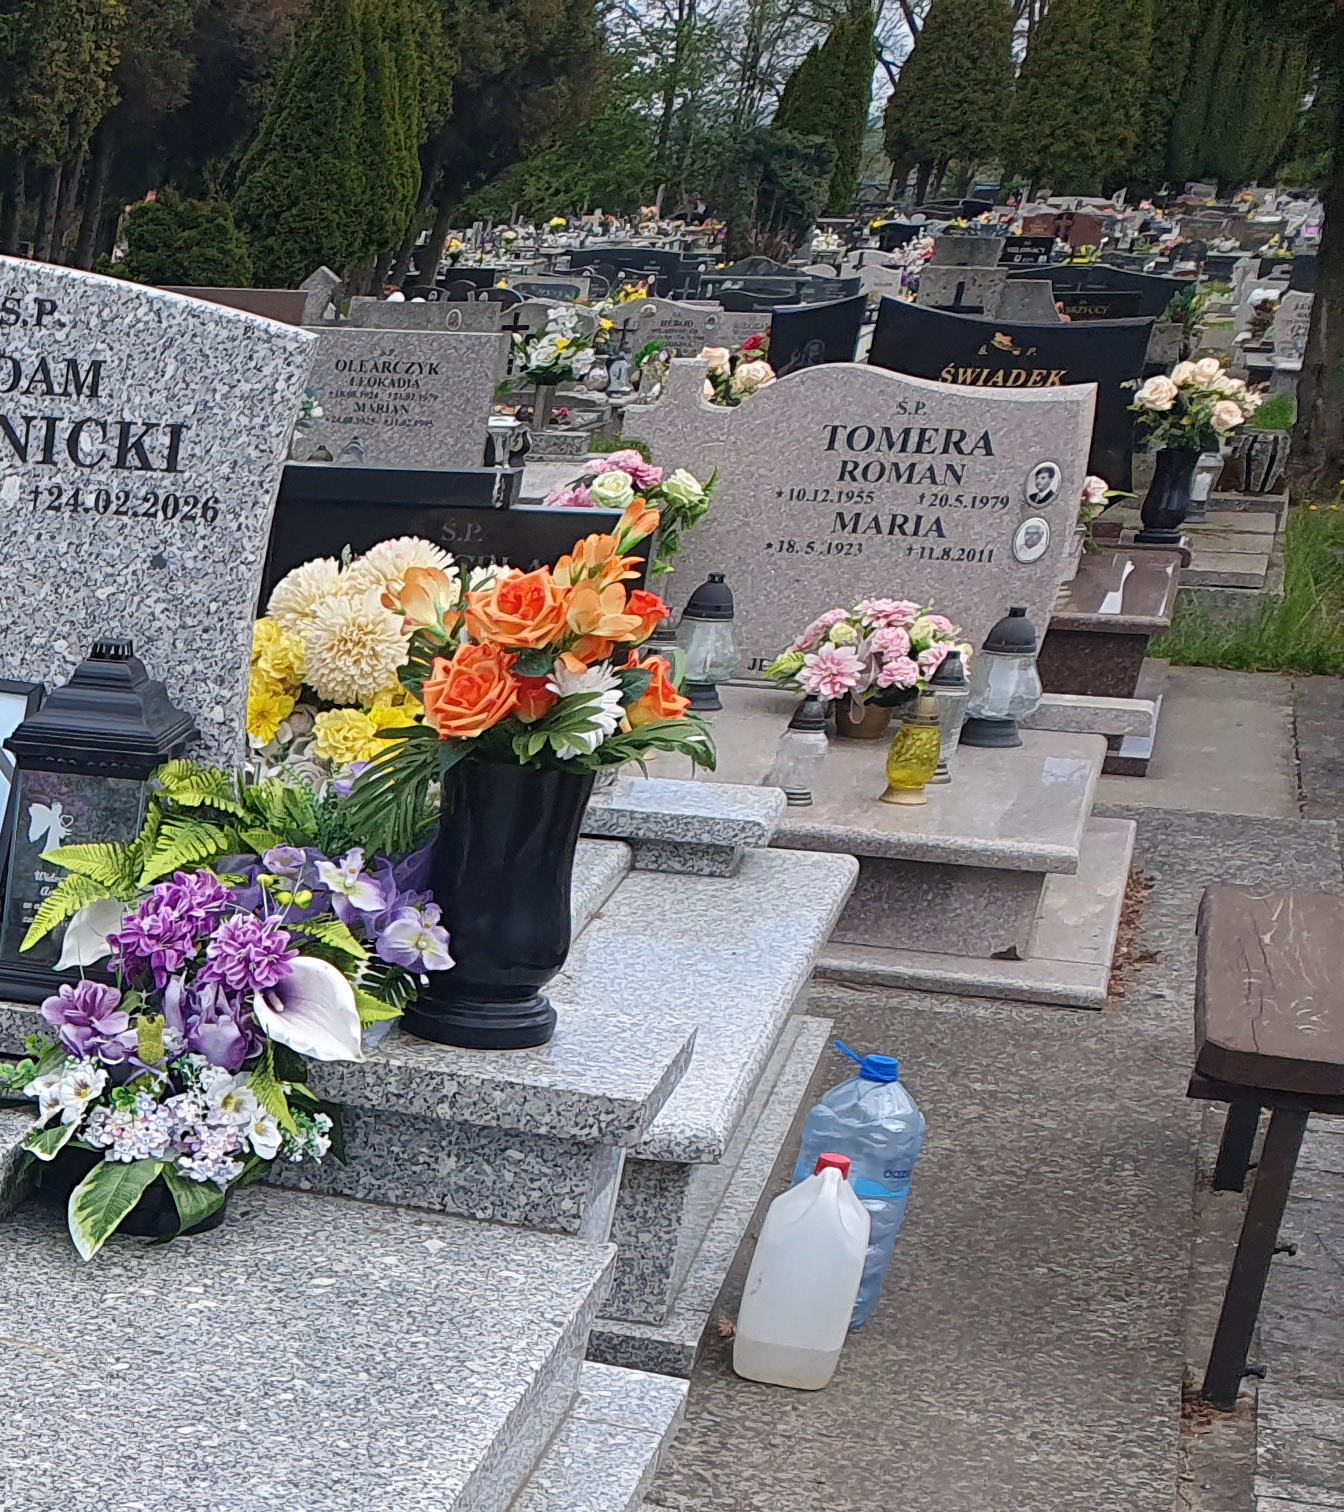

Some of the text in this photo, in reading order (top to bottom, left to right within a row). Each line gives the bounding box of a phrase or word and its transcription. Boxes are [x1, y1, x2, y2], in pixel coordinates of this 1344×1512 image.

[334, 359, 442, 376] OLEARCZYK
[938, 361, 1070, 388] ŚWIADEK
[348, 375, 421, 390] LEOKADIA
[352, 401, 410, 415] MARIAN
[822, 423, 996, 457] TOMERA
[836, 458, 967, 486] ROMAN
[929, 491, 1011, 511] 20.5.1979
[830, 510, 948, 539] MARIA
